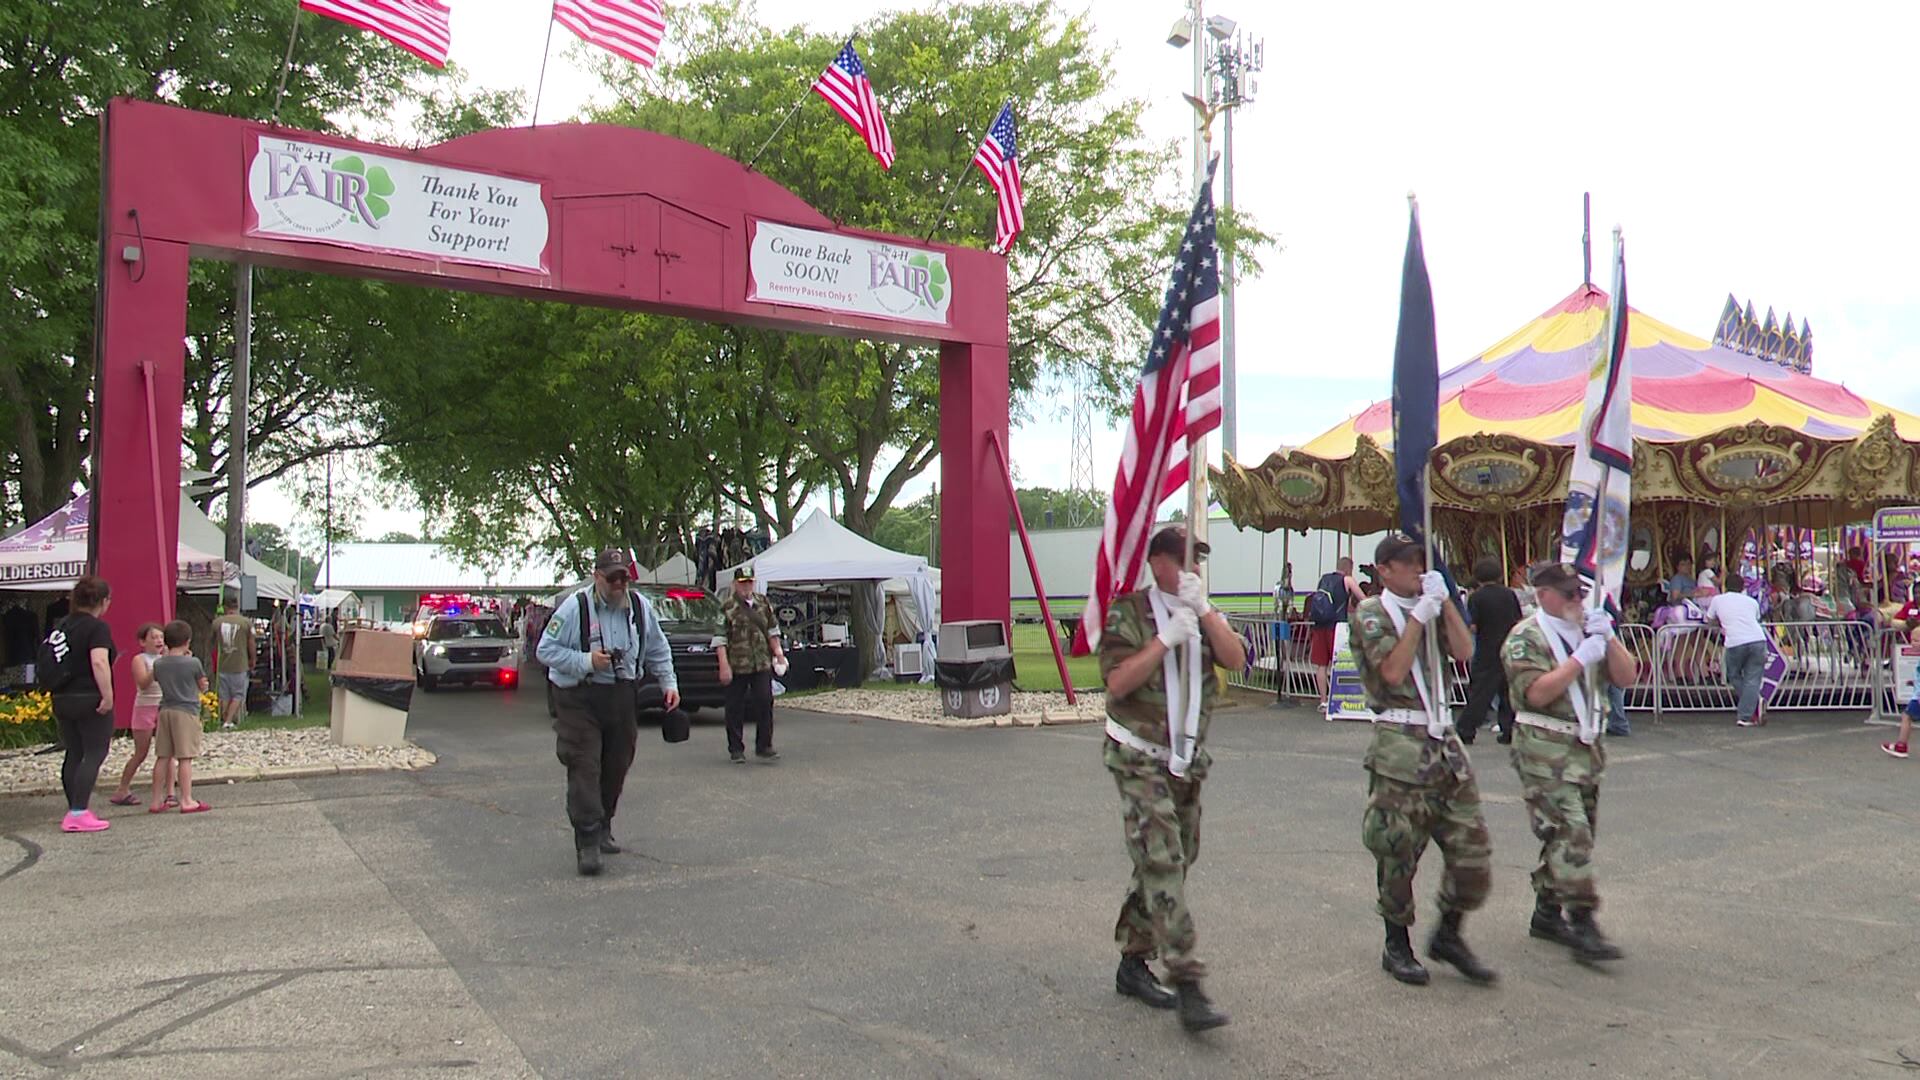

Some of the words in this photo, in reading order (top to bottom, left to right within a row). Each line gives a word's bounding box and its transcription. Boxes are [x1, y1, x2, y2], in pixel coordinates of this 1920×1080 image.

[285, 142, 304, 153] The
[303, 148, 332, 165] 4-H
[263, 147, 381, 231] FAIR
[421, 175, 480, 201] Thank
[486, 186, 519, 207] You
[428, 200, 462, 221] For
[468, 206, 510, 229] Your
[428, 224, 510, 251] Support!
[770, 236, 812, 259] Come
[816, 244, 852, 265] Back
[783, 260, 839, 285] SOON!
[867, 249, 938, 311] FAIR
[768, 281, 801, 297] Reentry
[801, 286, 827, 298] Passes
[828, 290, 846, 303] Only
